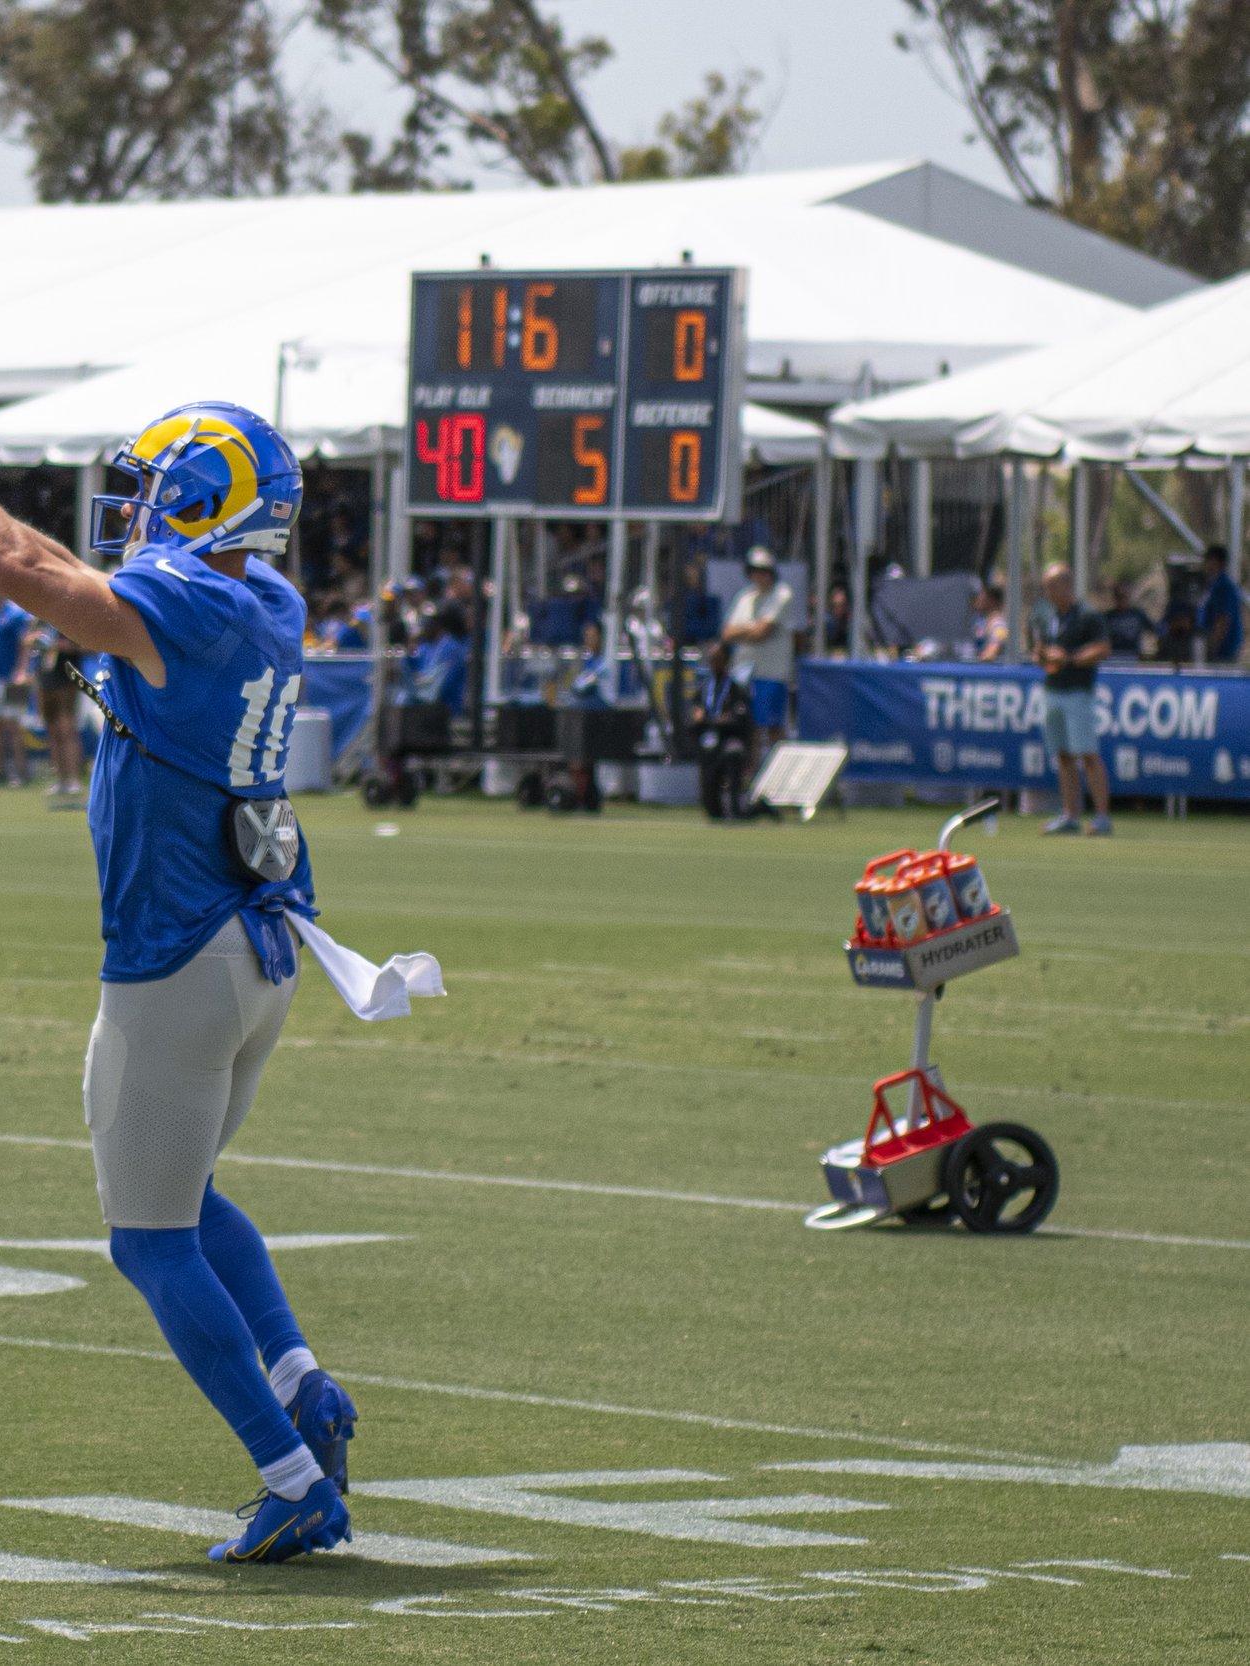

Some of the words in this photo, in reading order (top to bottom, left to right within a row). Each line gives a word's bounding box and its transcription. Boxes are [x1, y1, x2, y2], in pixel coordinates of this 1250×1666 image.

[674, 310, 707, 382] 0
[416, 412, 486, 502] 40
[572, 415, 609, 505] 5
[668, 430, 701, 502] 0
[920, 678, 1219, 740] THERAS.COM
[921, 926, 1006, 967] HYDRATER
[367, 1556, 1191, 1618] CREDIT
